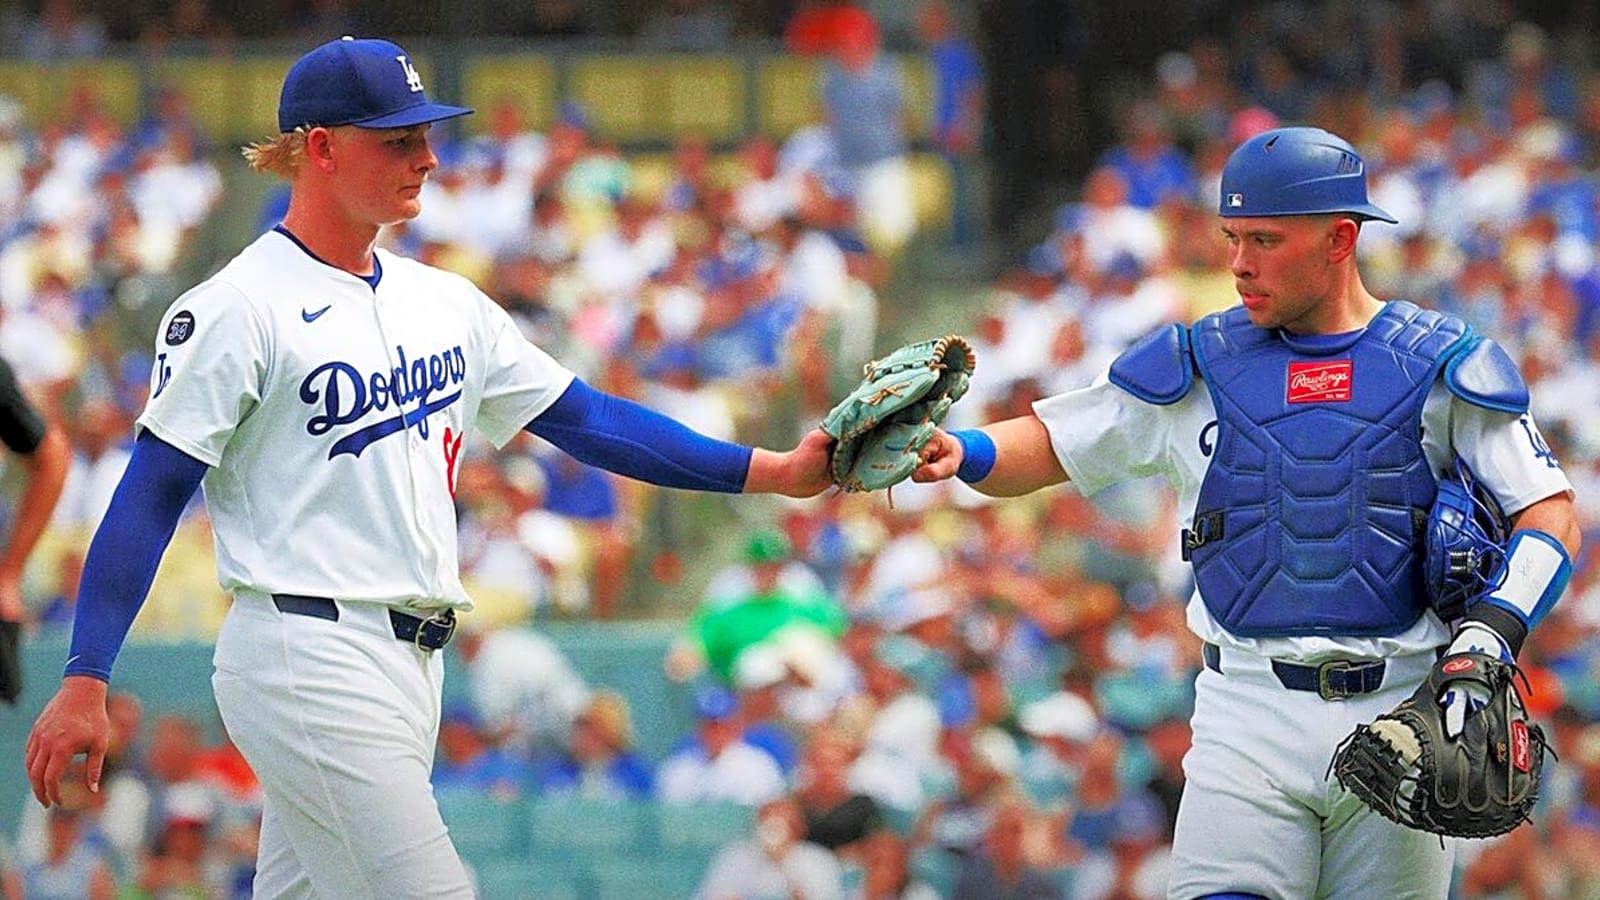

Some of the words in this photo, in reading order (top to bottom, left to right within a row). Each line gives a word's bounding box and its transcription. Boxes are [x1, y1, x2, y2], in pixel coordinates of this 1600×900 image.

[396, 55, 424, 92] LA
[299, 344, 466, 441] Dodgers
[1519, 418, 1564, 471] LA
